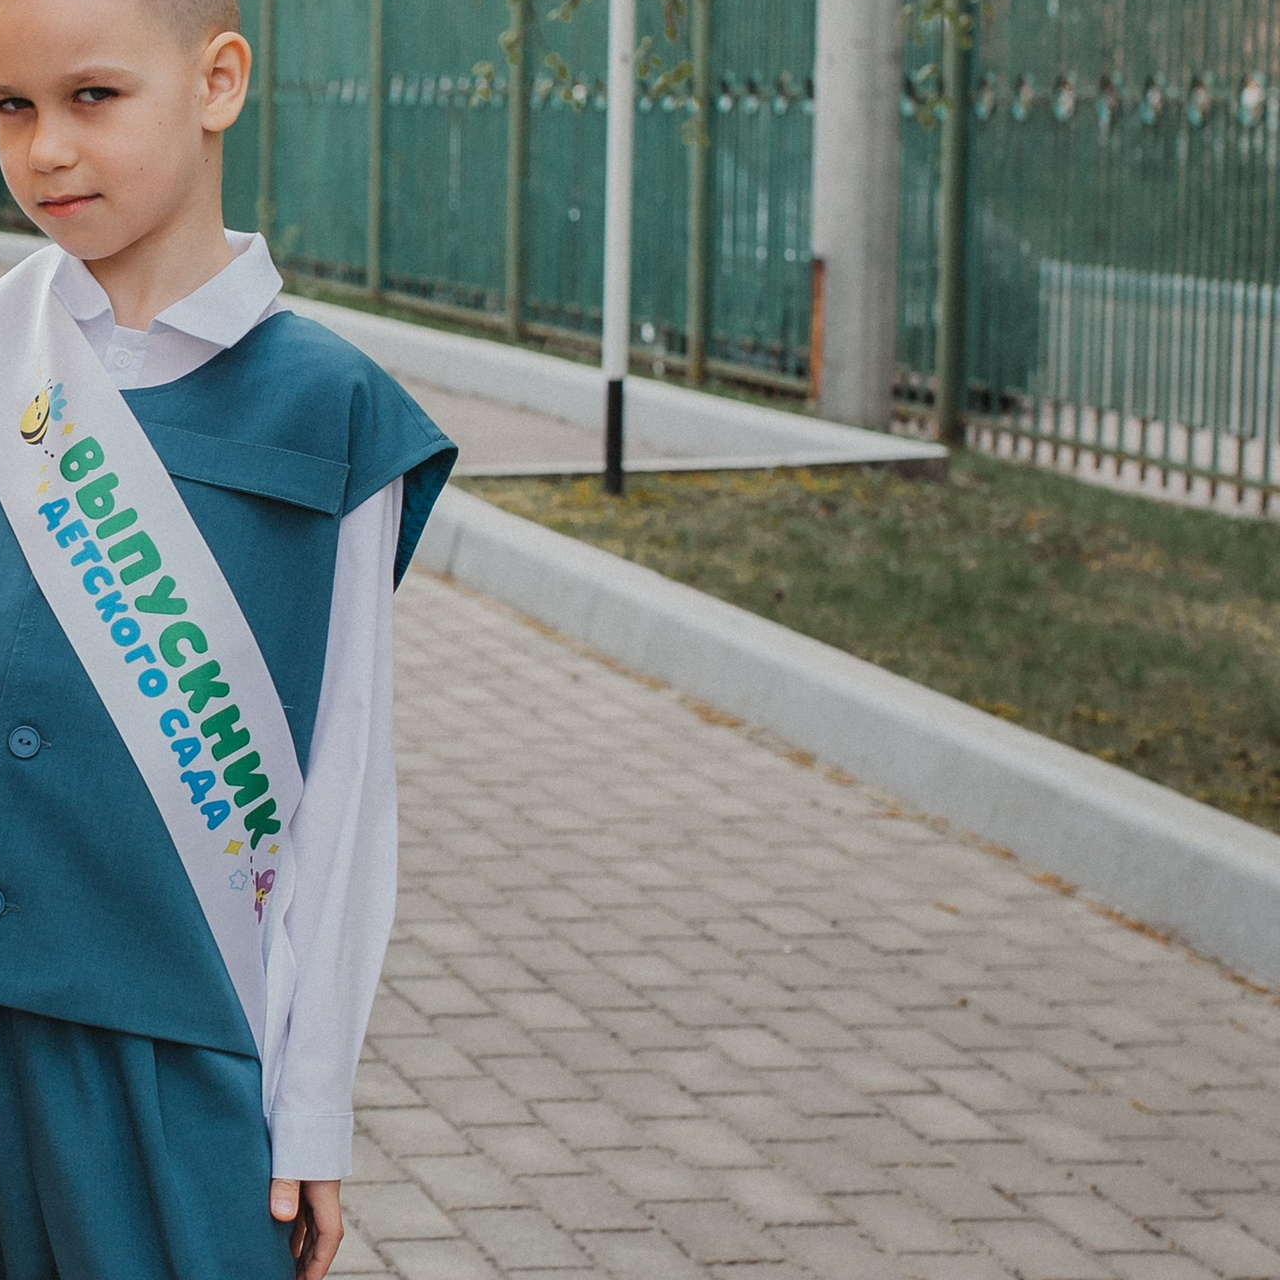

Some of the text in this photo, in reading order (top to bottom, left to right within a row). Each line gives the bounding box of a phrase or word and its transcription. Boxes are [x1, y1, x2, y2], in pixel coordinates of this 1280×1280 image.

[38, 497, 231, 831] ДЕТСКОГО САДА
[60, 436, 281, 850] ВЫПУСКНИК
